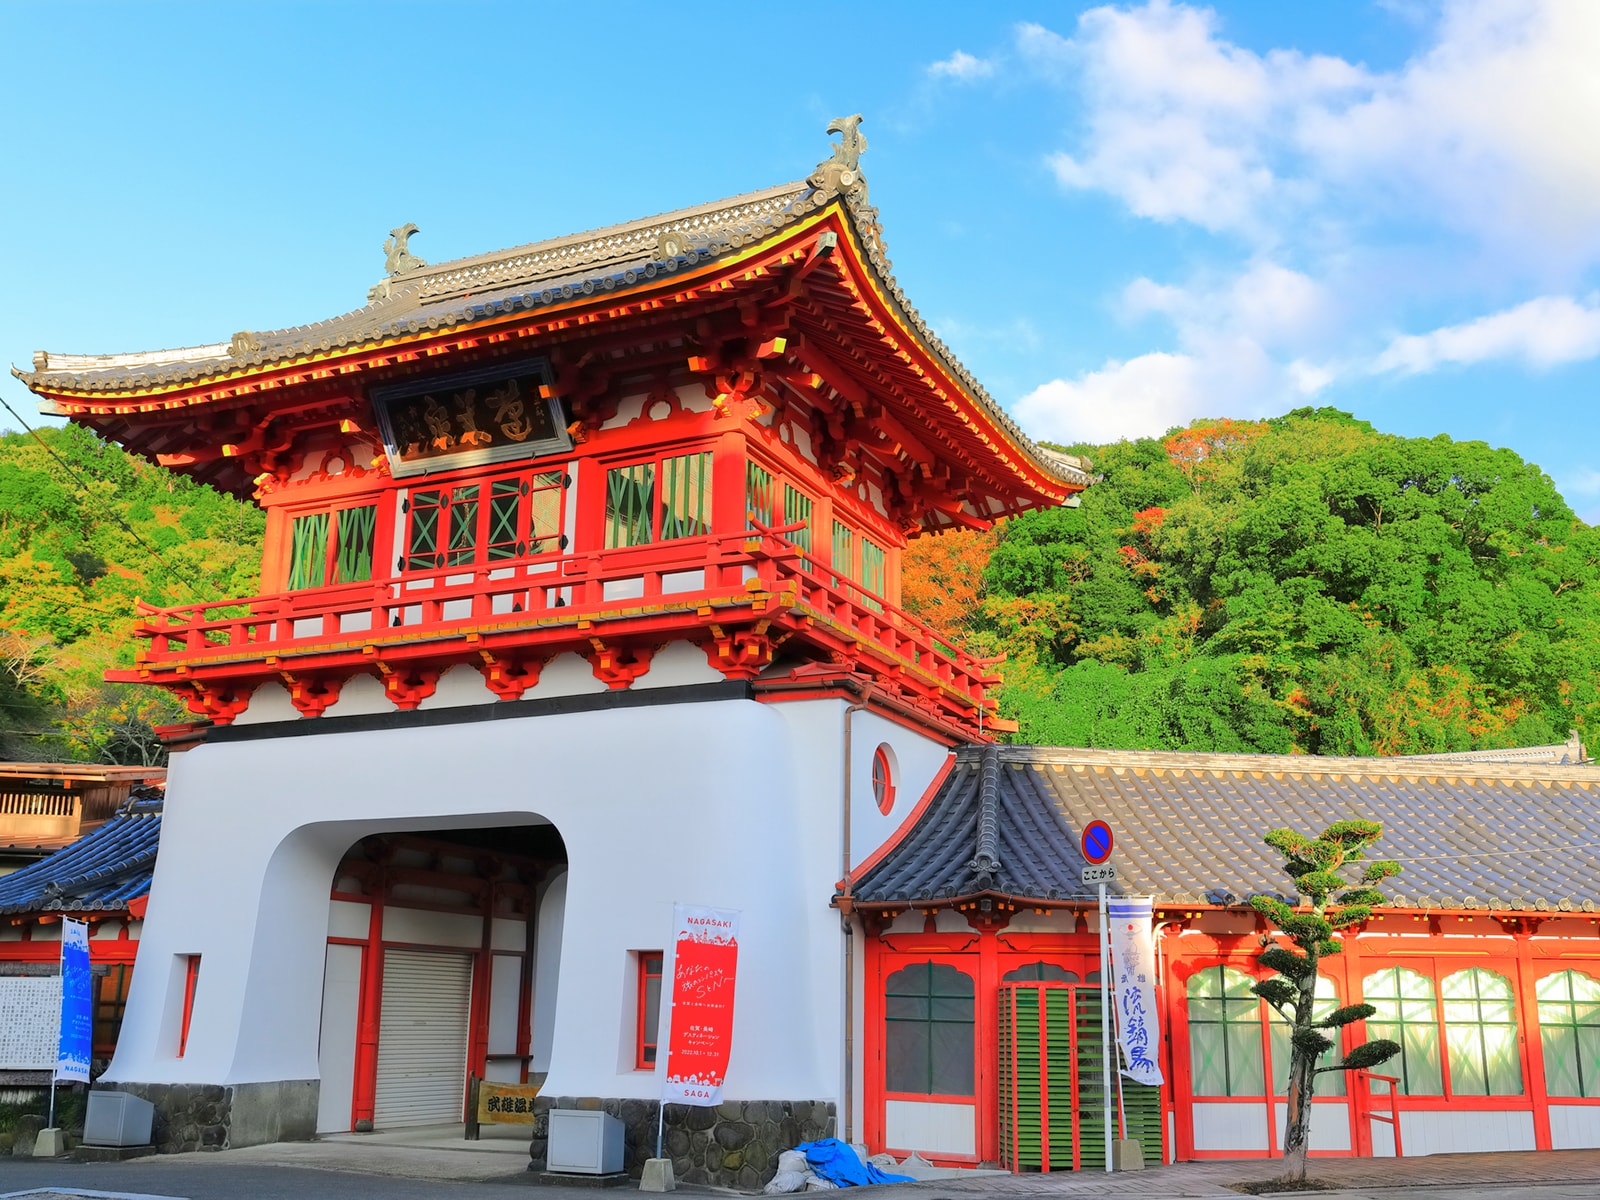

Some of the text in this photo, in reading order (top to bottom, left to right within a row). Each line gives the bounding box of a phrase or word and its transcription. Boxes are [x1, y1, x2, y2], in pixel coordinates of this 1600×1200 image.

[1083, 868, 1115, 881] ここから
[687, 917, 732, 928] NAGASAKI
[1123, 986, 1154, 1074] 流鏑馬
[684, 1089, 710, 1098] SAGA
